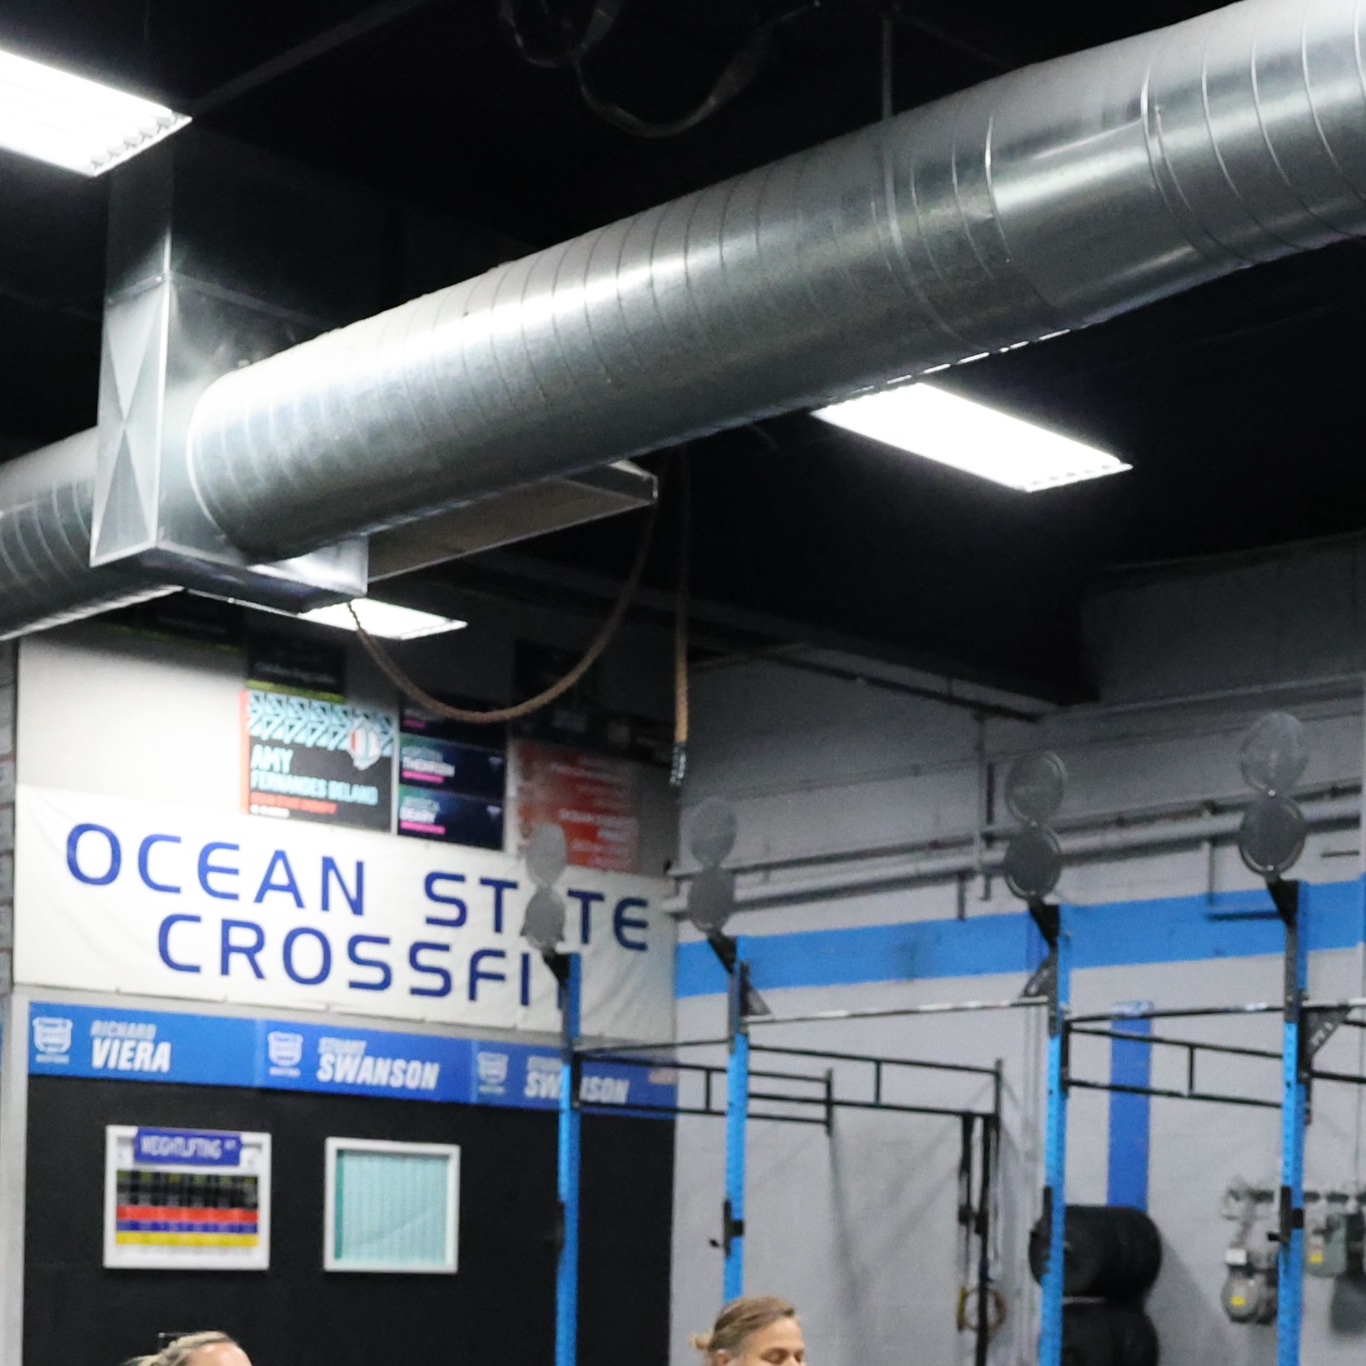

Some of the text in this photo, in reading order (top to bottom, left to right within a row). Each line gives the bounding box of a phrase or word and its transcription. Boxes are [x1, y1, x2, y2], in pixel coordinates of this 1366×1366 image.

[251, 745, 294, 773] AMY
[67, 823, 649, 952] OCEAN STTE
[157, 913, 563, 1008] CROSSFI
[91, 1038, 172, 1073] VIERA
[316, 1053, 441, 1090] SWANSON
[524, 1071, 630, 1104] SWSON
